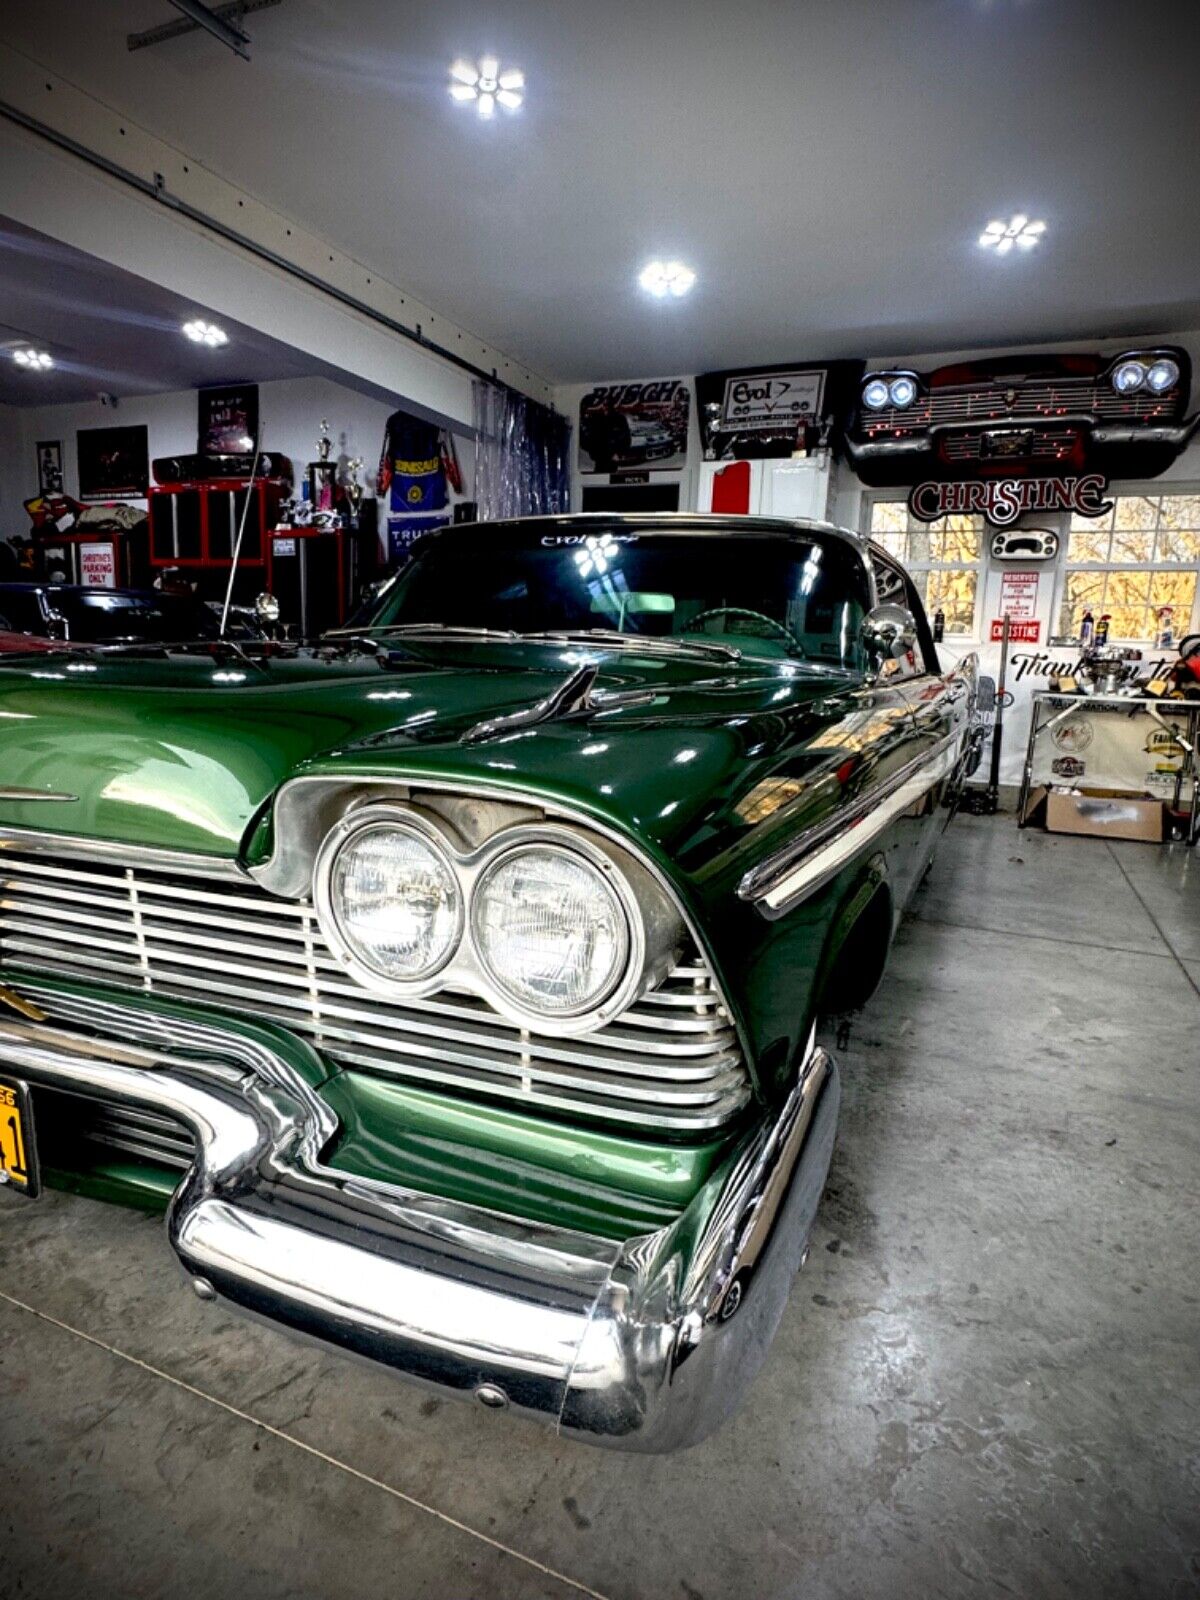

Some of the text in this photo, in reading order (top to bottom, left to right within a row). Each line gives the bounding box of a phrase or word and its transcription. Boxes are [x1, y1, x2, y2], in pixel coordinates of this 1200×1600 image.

[589, 381, 682, 407] BUSCH
[912, 474, 1112, 525] CHRISTINE
[83, 563, 111, 573] PARKING
[89, 574, 105, 583] ONLY
